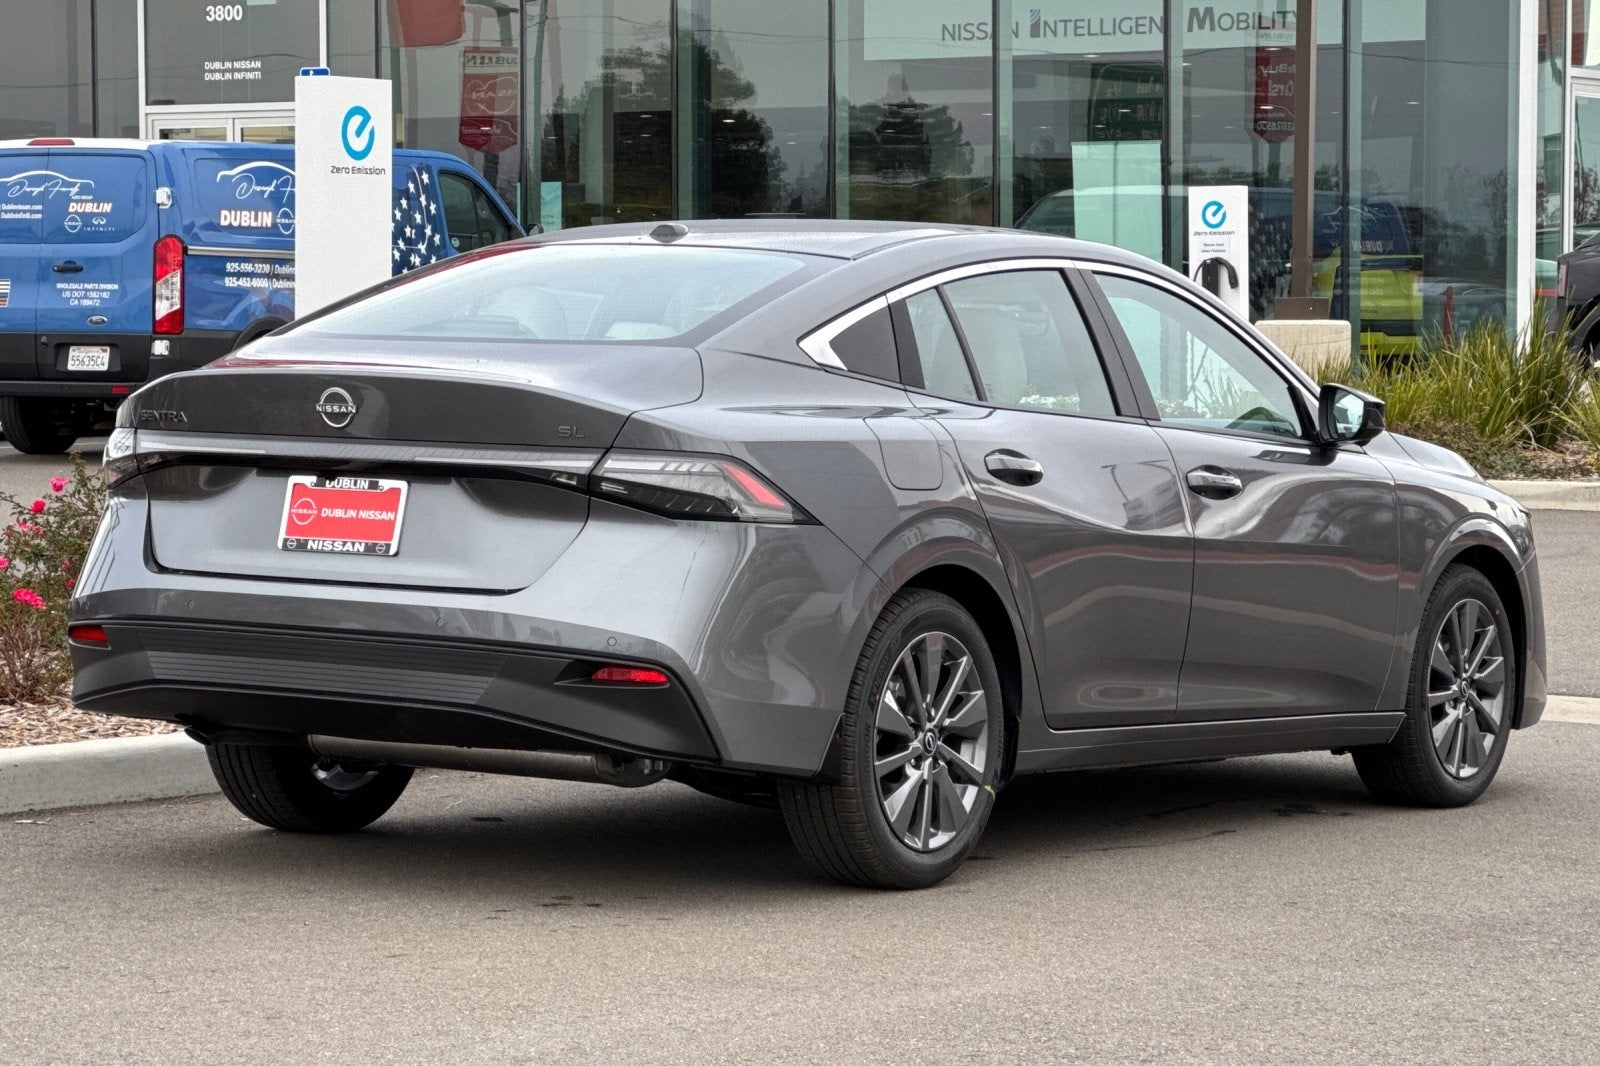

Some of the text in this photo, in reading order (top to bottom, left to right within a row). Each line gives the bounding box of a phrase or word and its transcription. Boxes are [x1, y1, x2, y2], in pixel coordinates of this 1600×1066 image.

[206, 5, 243, 21] 3800
[942, 22, 1019, 41] NISSN
[1030, 9, 1164, 38] INTELLIGEN
[204, 60, 262, 70] DUBLIN NISSAN
[204, 71, 262, 81] DUBLIN INFINITI
[330, 165, 386, 175] Zero Emission
[68, 202, 112, 213] DUBLIN
[220, 209, 272, 227] DUBLIN
[69, 298, 79, 306] CA
[70, 355, 105, 367] 55635C4
[316, 403, 356, 414] NISSAN
[140, 409, 188, 423] SENTRA
[558, 425, 585, 438] SL
[325, 479, 369, 490] DUBLIN
[321, 508, 357, 518] DUBLIN
[358, 510, 395, 520] NISSAN
[307, 540, 366, 552] NISSAN
